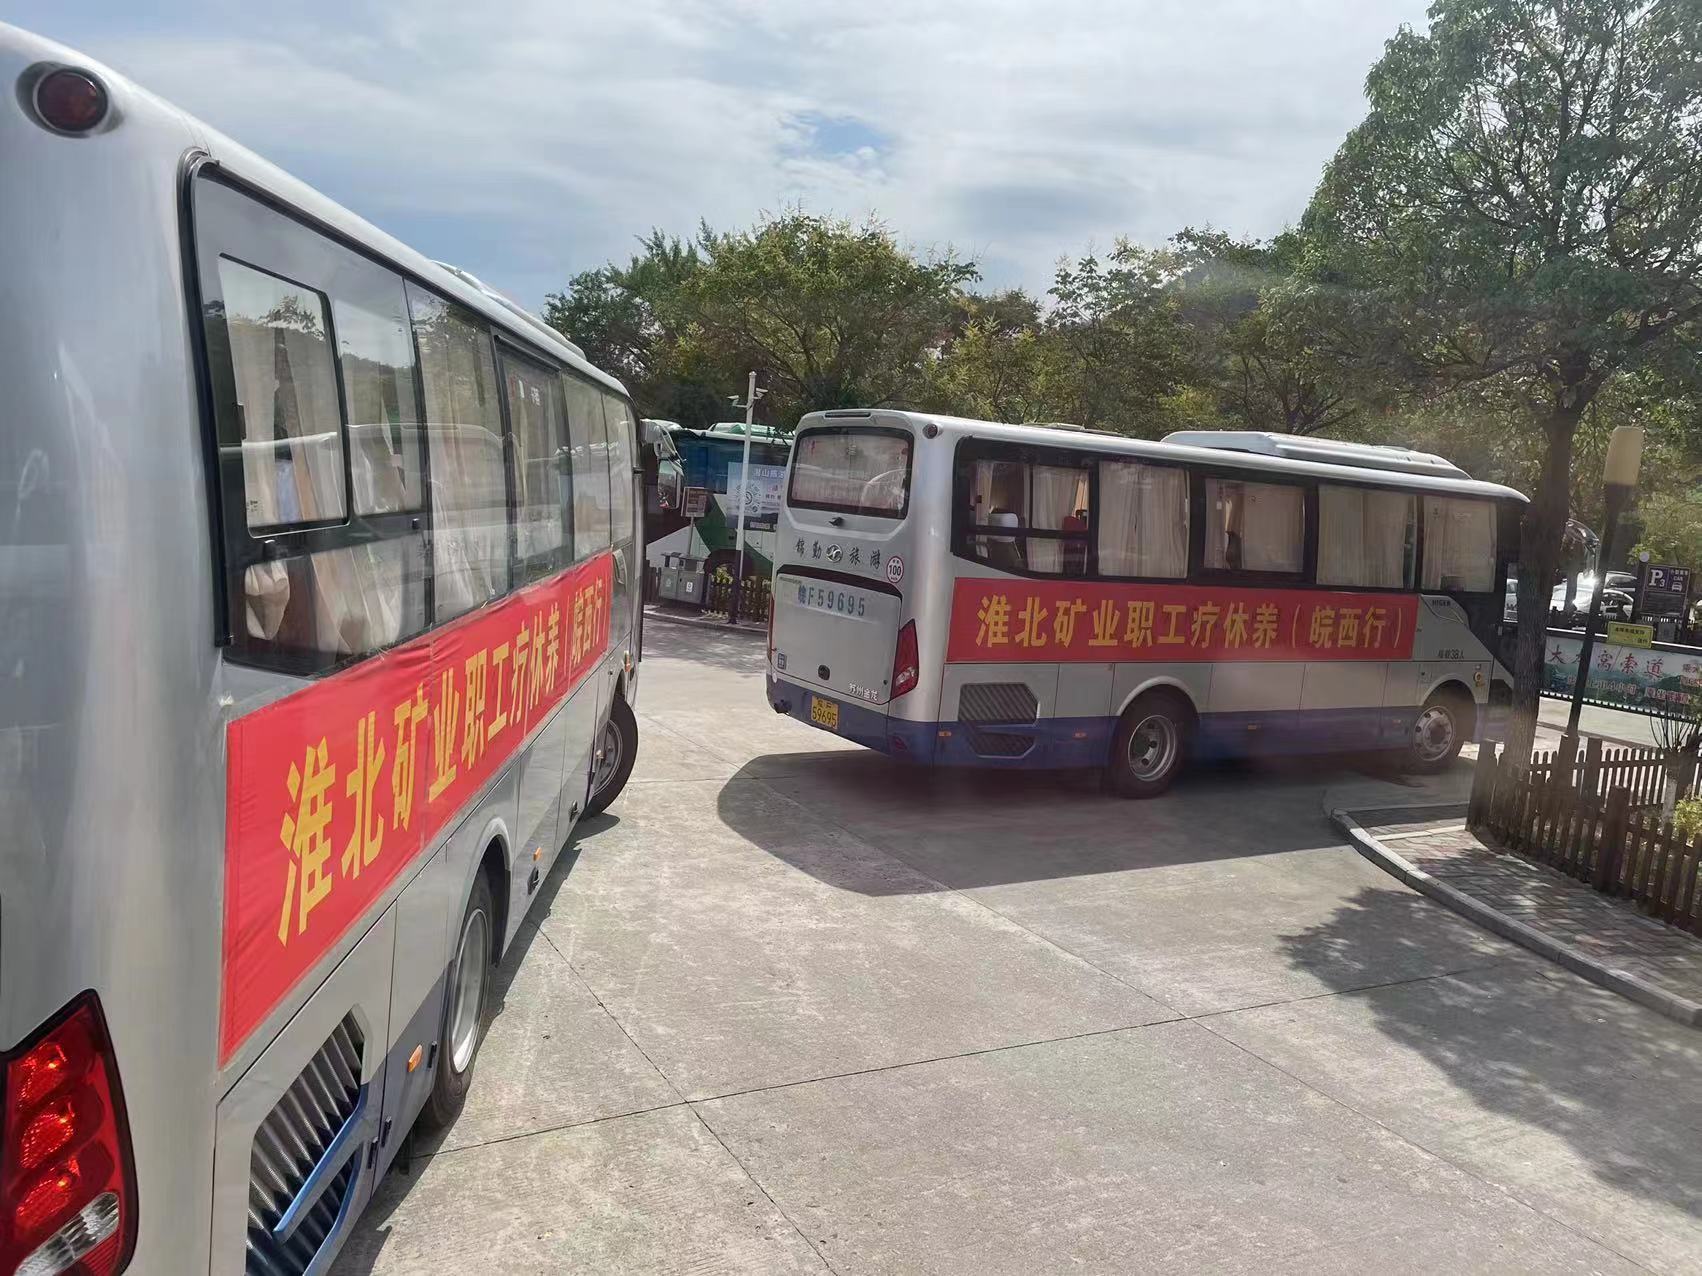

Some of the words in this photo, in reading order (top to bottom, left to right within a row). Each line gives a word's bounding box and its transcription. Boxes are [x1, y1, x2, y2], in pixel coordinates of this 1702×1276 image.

[888, 564, 902, 576] 100
[848, 682, 878, 701] 苏州金龙
[812, 706, 837, 727] 59695
